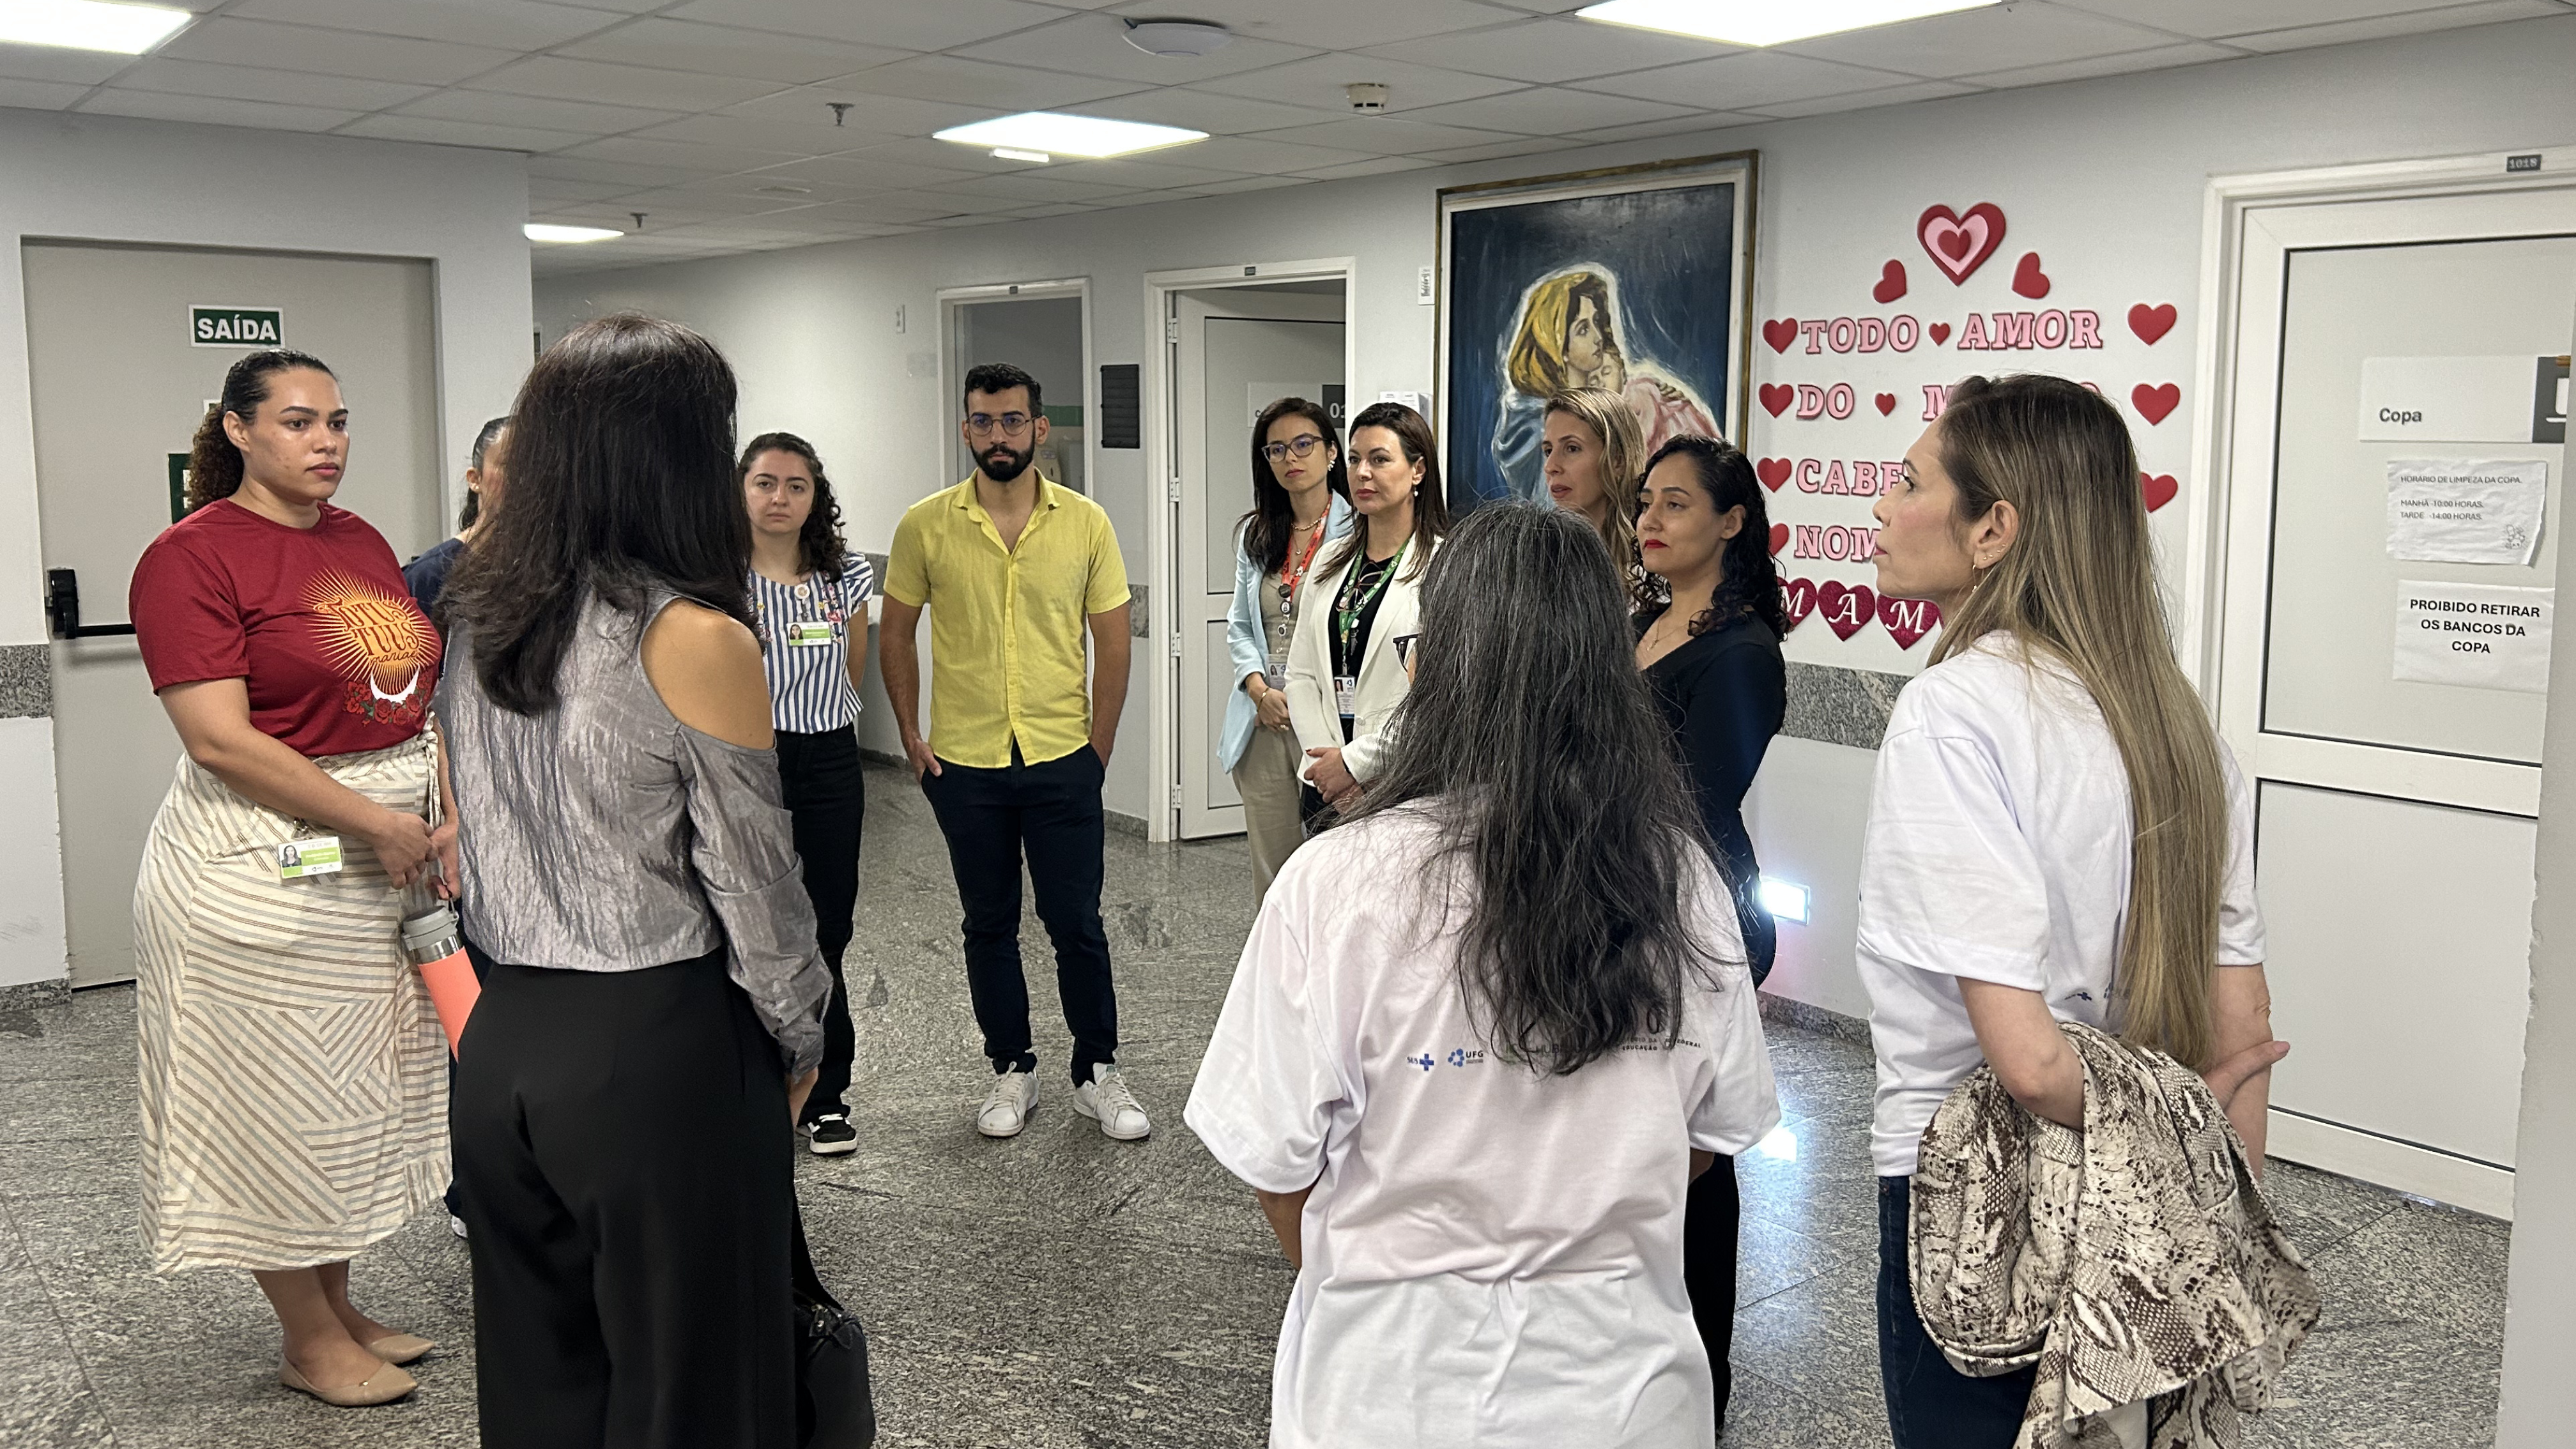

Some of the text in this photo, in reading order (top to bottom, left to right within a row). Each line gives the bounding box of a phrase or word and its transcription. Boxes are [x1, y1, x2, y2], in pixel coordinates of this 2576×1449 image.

[197, 314, 277, 341] SAÍDA
[1800, 309, 2103, 355] TODO AMOR
[1796, 383, 1854, 420] DO
[2379, 407, 2422, 425] Copa
[2437, 475, 2448, 484] DE
[2449, 475, 2483, 484] LIMPEZA
[1793, 525, 1881, 563] NOM
[1780, 585, 1924, 634] MAM
[2410, 599, 2541, 618] PROIBIDO RETIRAR
[2421, 618, 2526, 636] OS BANCOS DA
[2451, 641, 2491, 654] COPA
[1466, 1050, 1483, 1059] UFG
